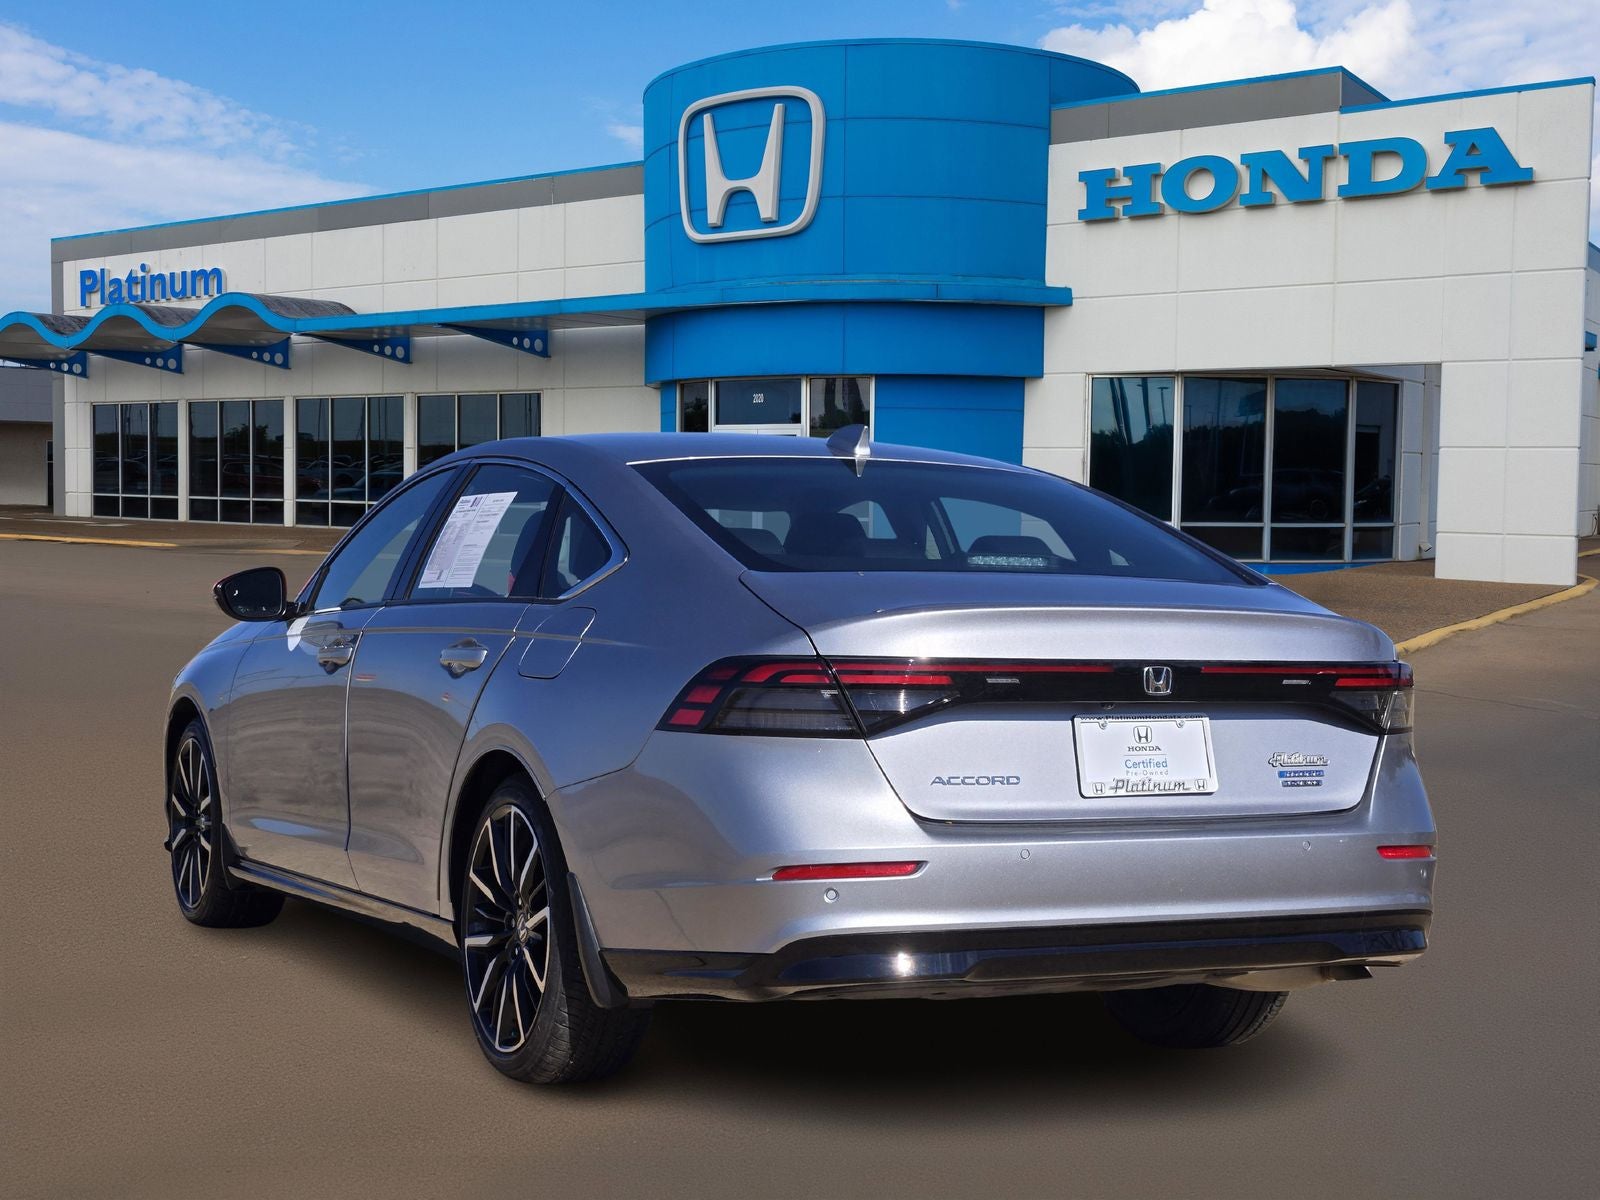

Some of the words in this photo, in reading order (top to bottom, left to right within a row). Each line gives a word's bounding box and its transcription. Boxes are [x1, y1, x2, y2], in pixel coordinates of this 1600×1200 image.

[1078, 126, 1534, 222] HONDA
[80, 263, 227, 307] Platinum
[1124, 758, 1168, 769] Certified
[930, 775, 1021, 786] ACCORD
[1109, 777, 1194, 794] Platinum
